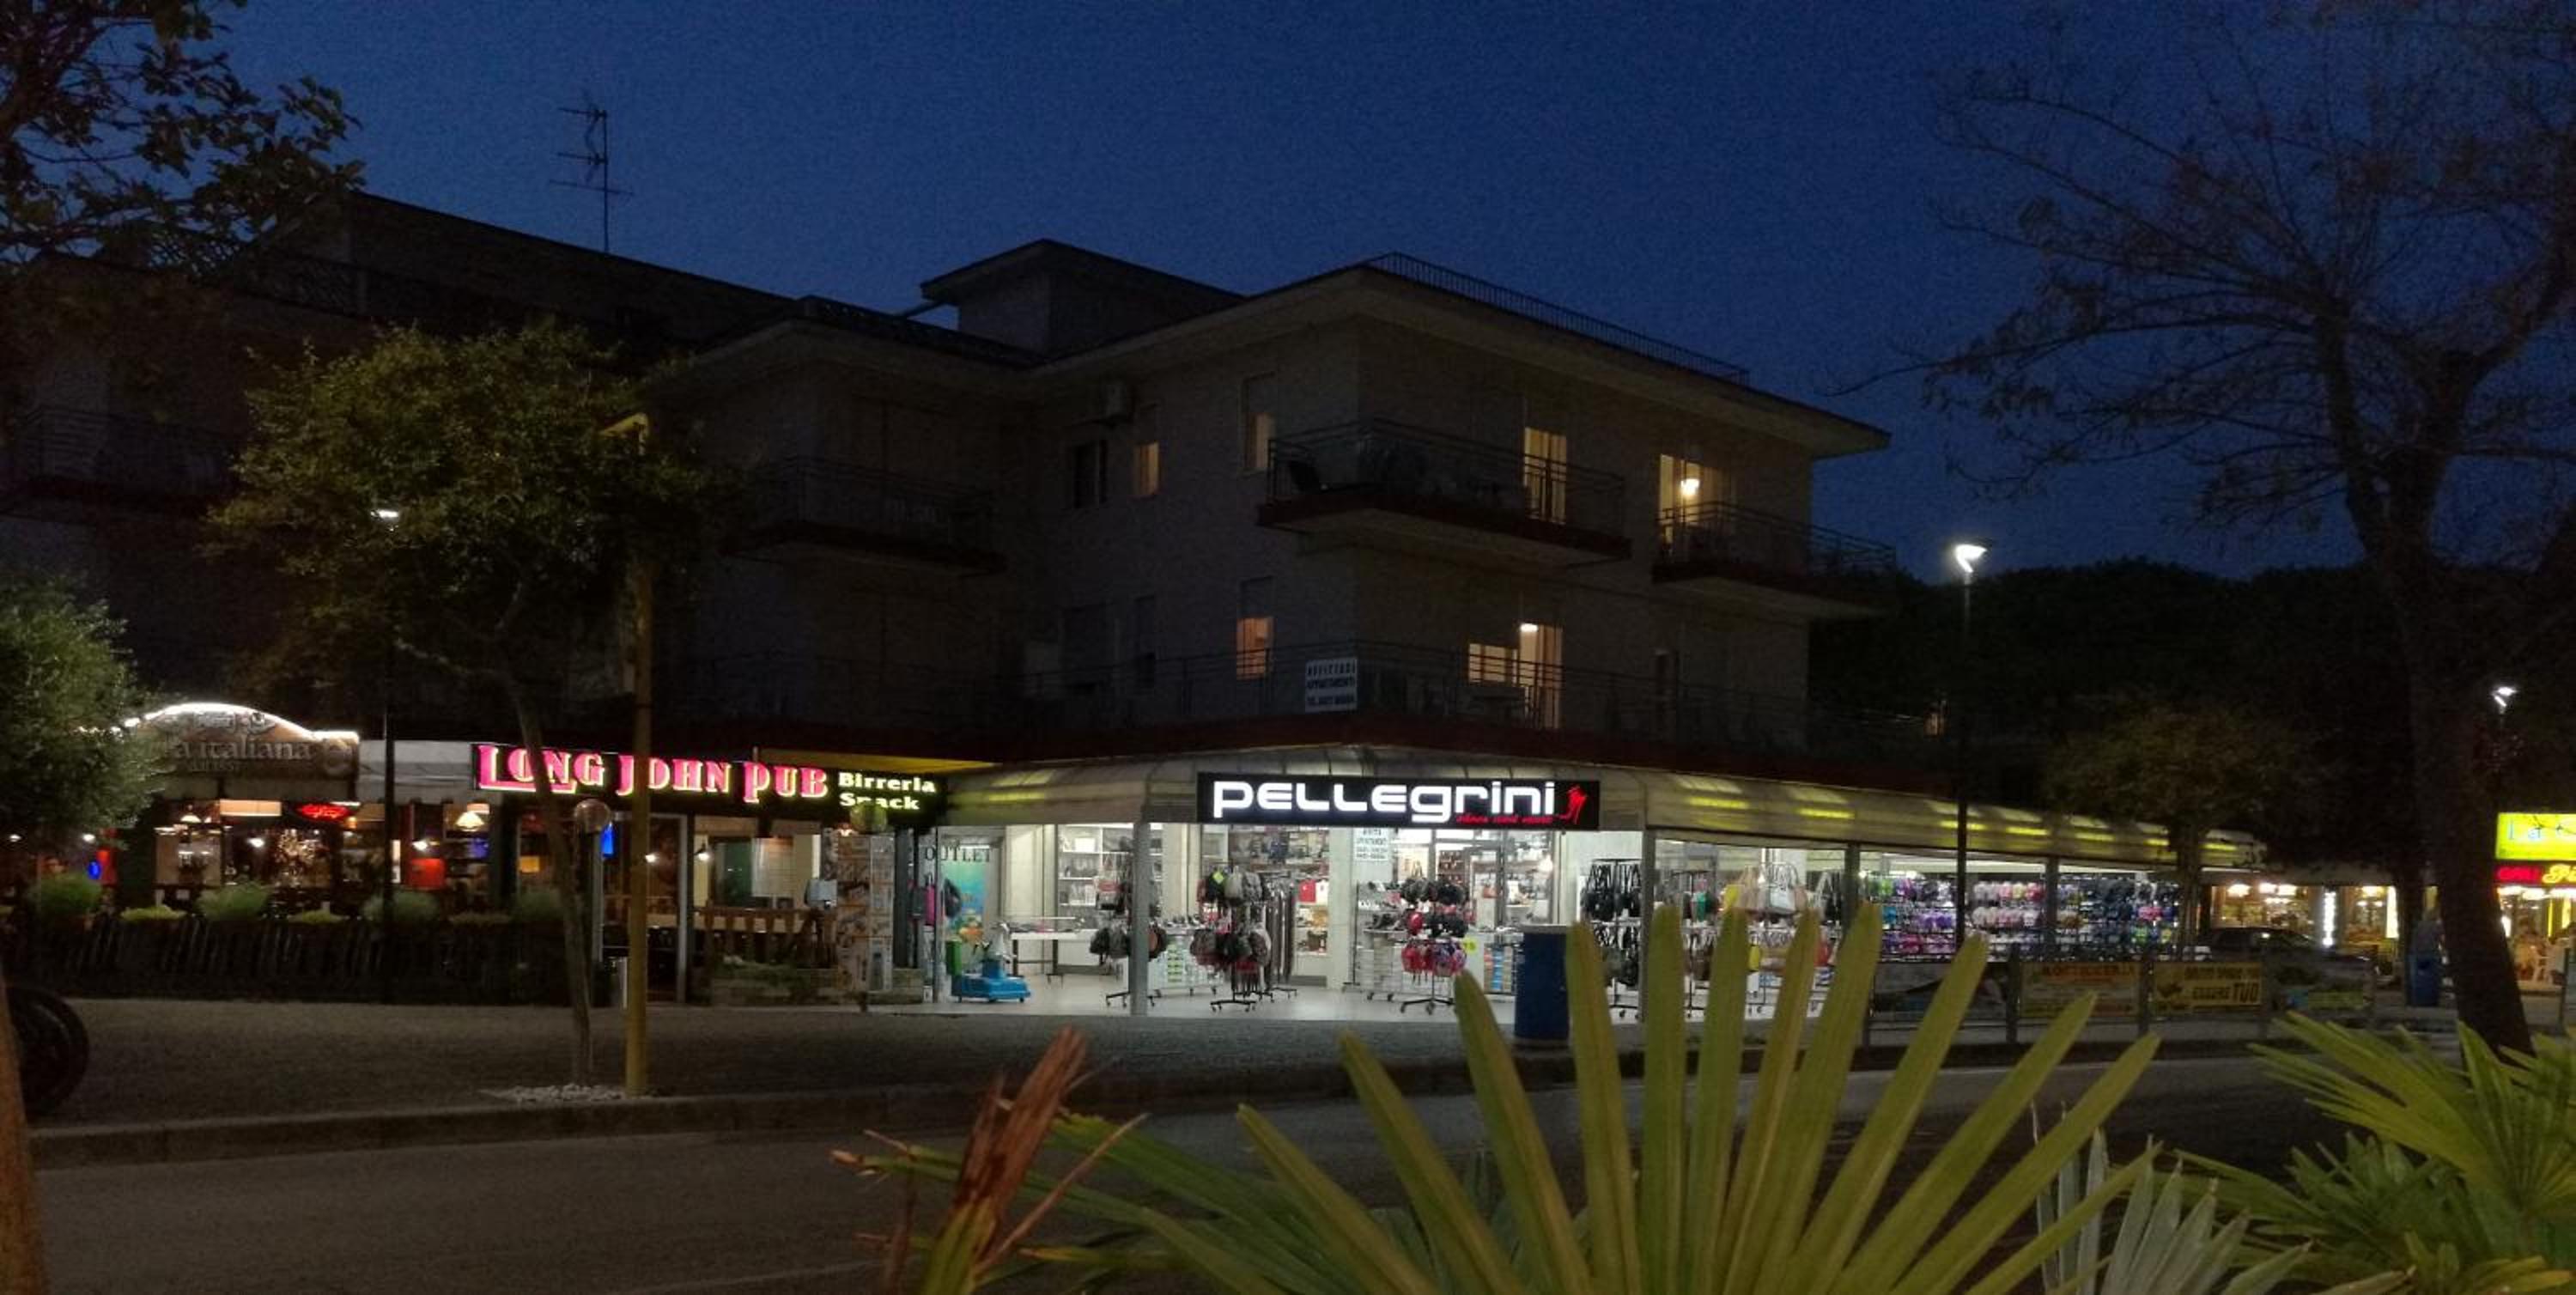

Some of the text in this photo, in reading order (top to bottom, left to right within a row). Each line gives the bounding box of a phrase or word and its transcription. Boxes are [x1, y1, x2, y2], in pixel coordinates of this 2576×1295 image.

[477, 744, 829, 804] LONG JOHN PUB
[838, 771, 937, 793] Birreria
[924, 845, 991, 863] OUTLET
